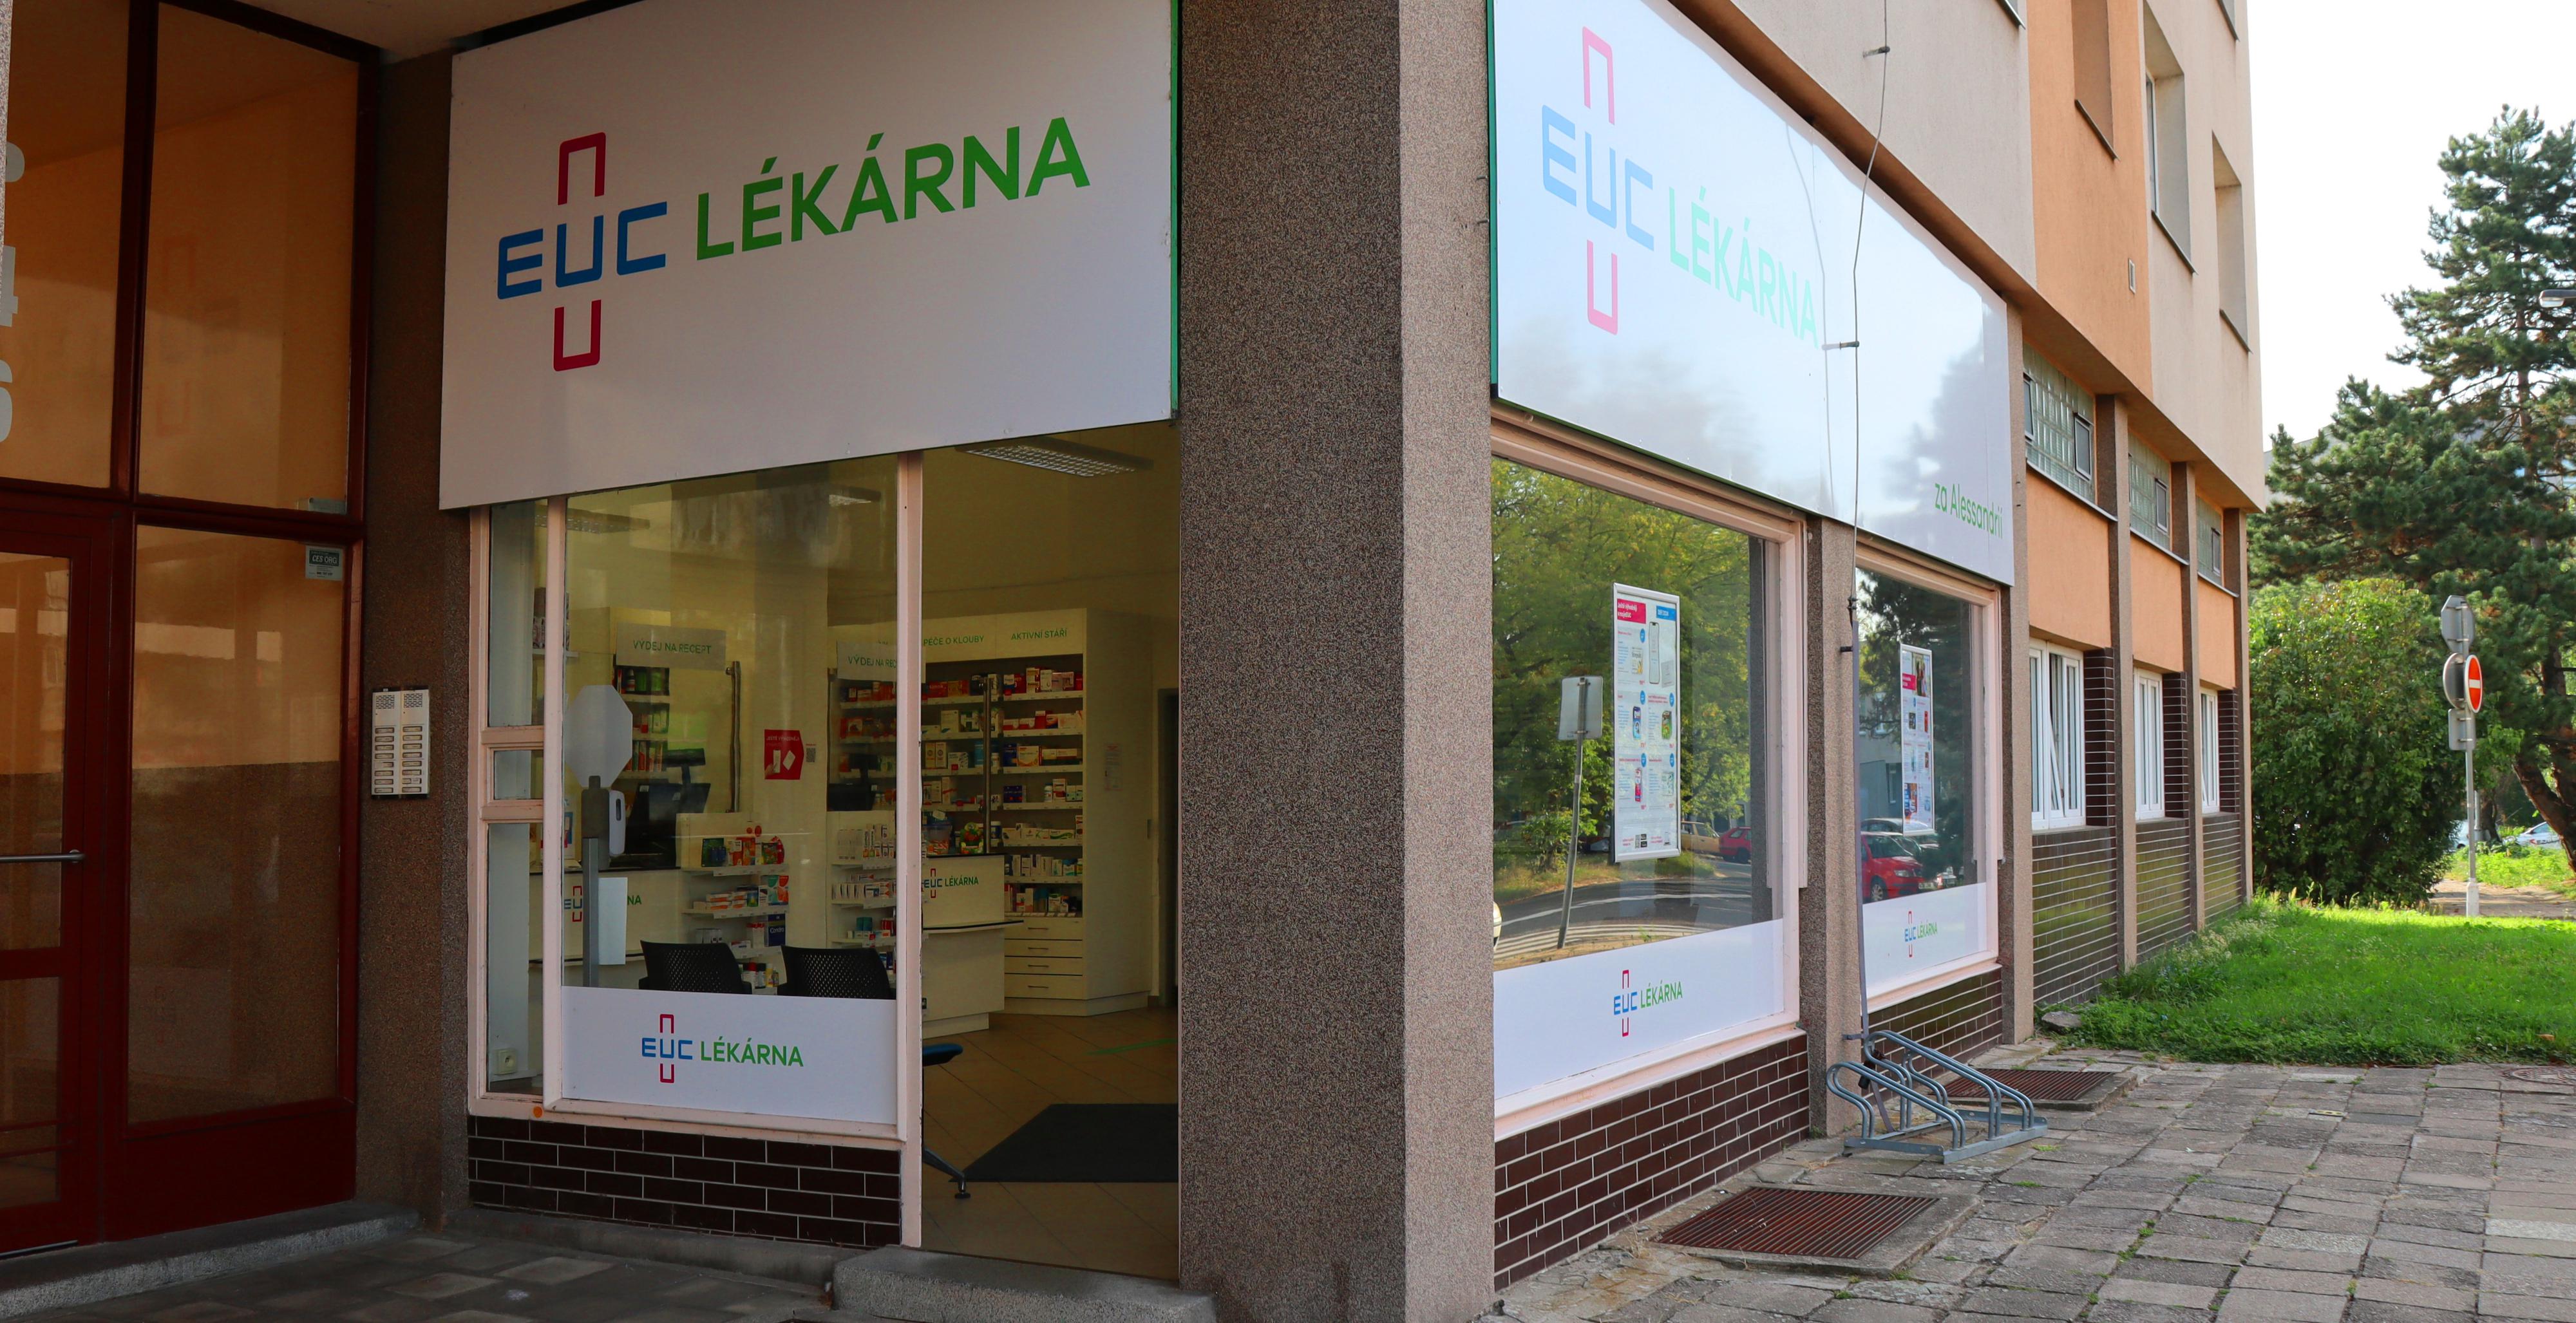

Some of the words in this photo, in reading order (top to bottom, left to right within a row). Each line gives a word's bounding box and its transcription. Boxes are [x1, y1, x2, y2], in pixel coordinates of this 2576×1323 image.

[497, 201, 667, 299] EUC
[696, 117, 1090, 260] LÉKÁRNA
[1541, 104, 1655, 252] EUC
[1668, 185, 1819, 350] LÉKÁRNA
[1935, 483, 1947, 513] za
[923, 636, 943, 646] PÉČE
[953, 635, 985, 644] KLOUBY
[1010, 629, 1042, 640] AKTIVNÍ
[1045, 628, 1067, 638] STÁŘÍ
[633, 639, 662, 651] VÝDEJ
[665, 643, 676, 652] NA
[679, 643, 712, 654] RECEPT
[848, 654, 874, 666] VÝDEJ
[923, 878, 943, 888] EUC
[945, 874, 980, 887] LÉKÁRNA
[564, 898, 583, 909] EU
[1904, 926, 1917, 942] EUC
[1917, 919, 1938, 939] LÉKÁRNA
[1613, 991, 1638, 1015] EUC
[1641, 979, 1683, 1009] LÉKÁRNA
[641, 1037, 693, 1060] EUC
[701, 1036, 804, 1067] LÉKÁRNA
